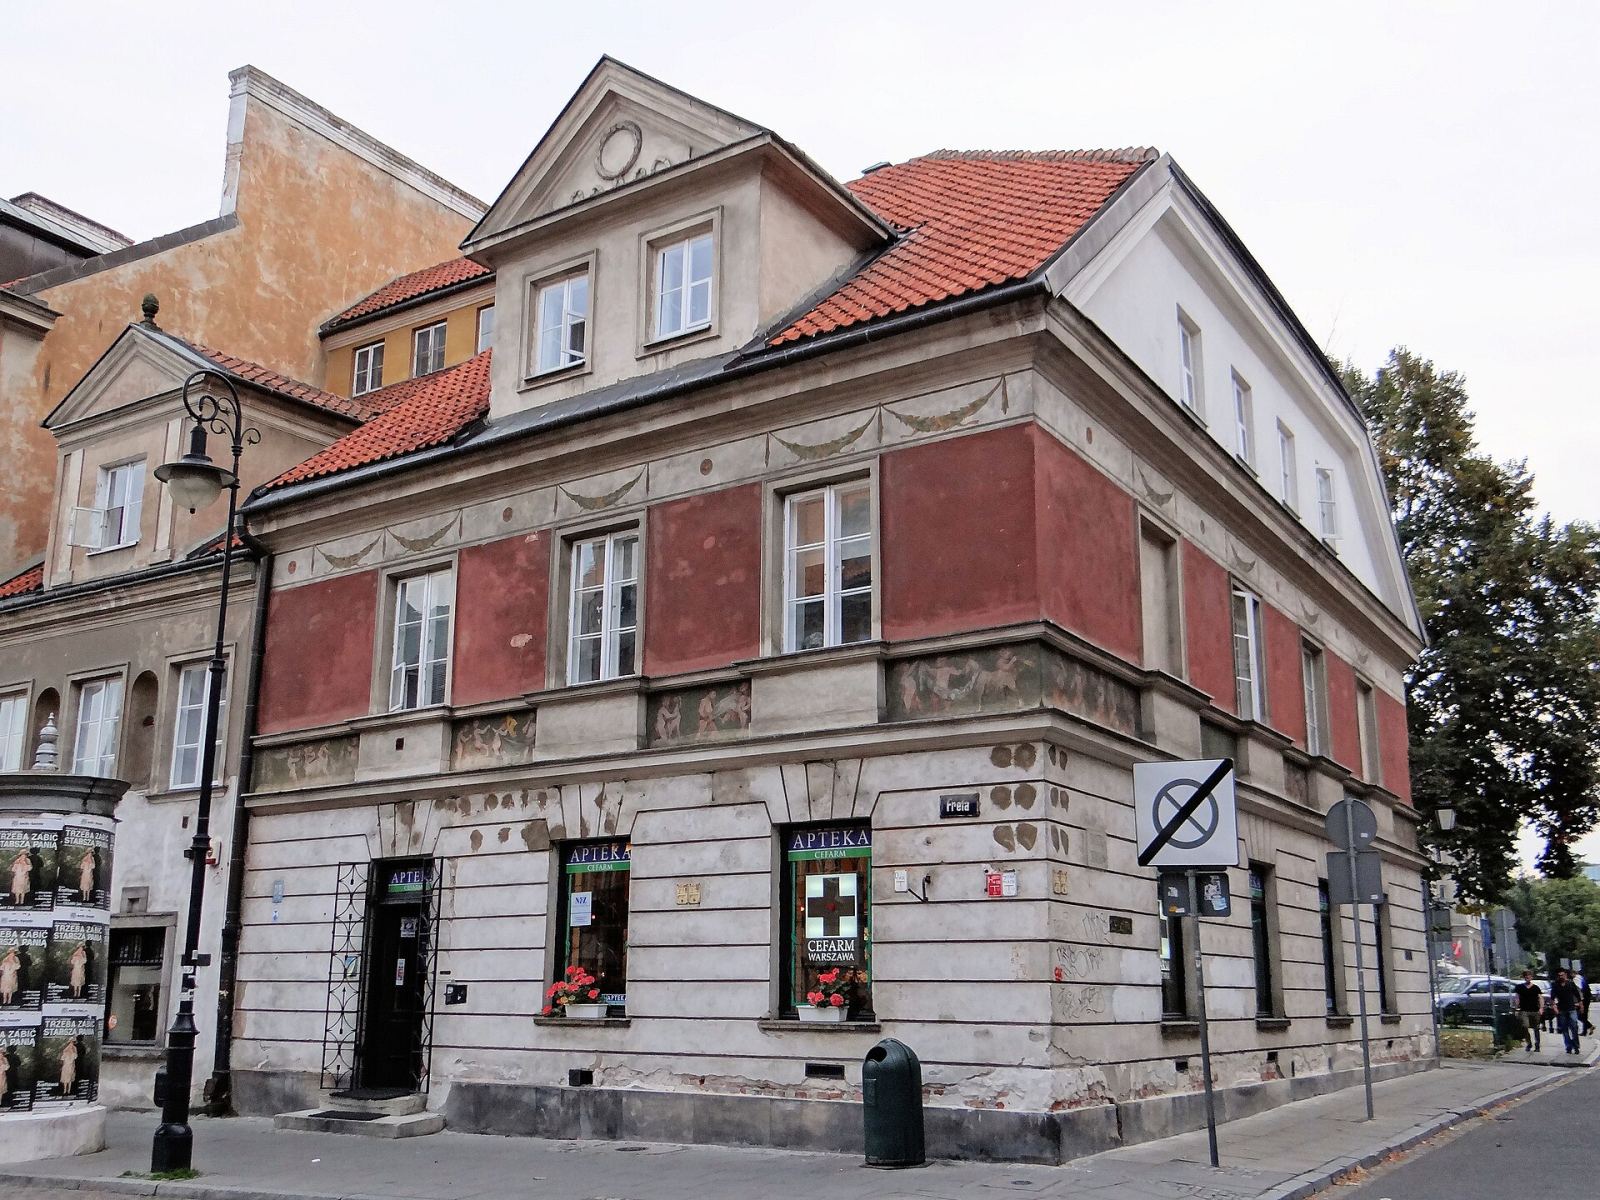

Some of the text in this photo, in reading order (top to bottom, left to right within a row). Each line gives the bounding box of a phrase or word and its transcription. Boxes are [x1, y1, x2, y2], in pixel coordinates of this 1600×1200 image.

[0, 832, 29, 840] RZEBA
[794, 829, 870, 849] APTEKA
[0, 840, 31, 848] TARSZĄ
[570, 843, 632, 863] APTEKA
[814, 850, 847, 859] CEFARM
[586, 864, 613, 872] CEFARM
[54, 924, 85, 933] TRZEBA
[20, 930, 49, 939] ZABIĆ
[807, 940, 855, 952] CEFARM
[808, 952, 855, 961] WARSZAWA
[45, 1020, 76, 1028] TRZEBA
[8, 1028, 37, 1038] ZABIĆ
